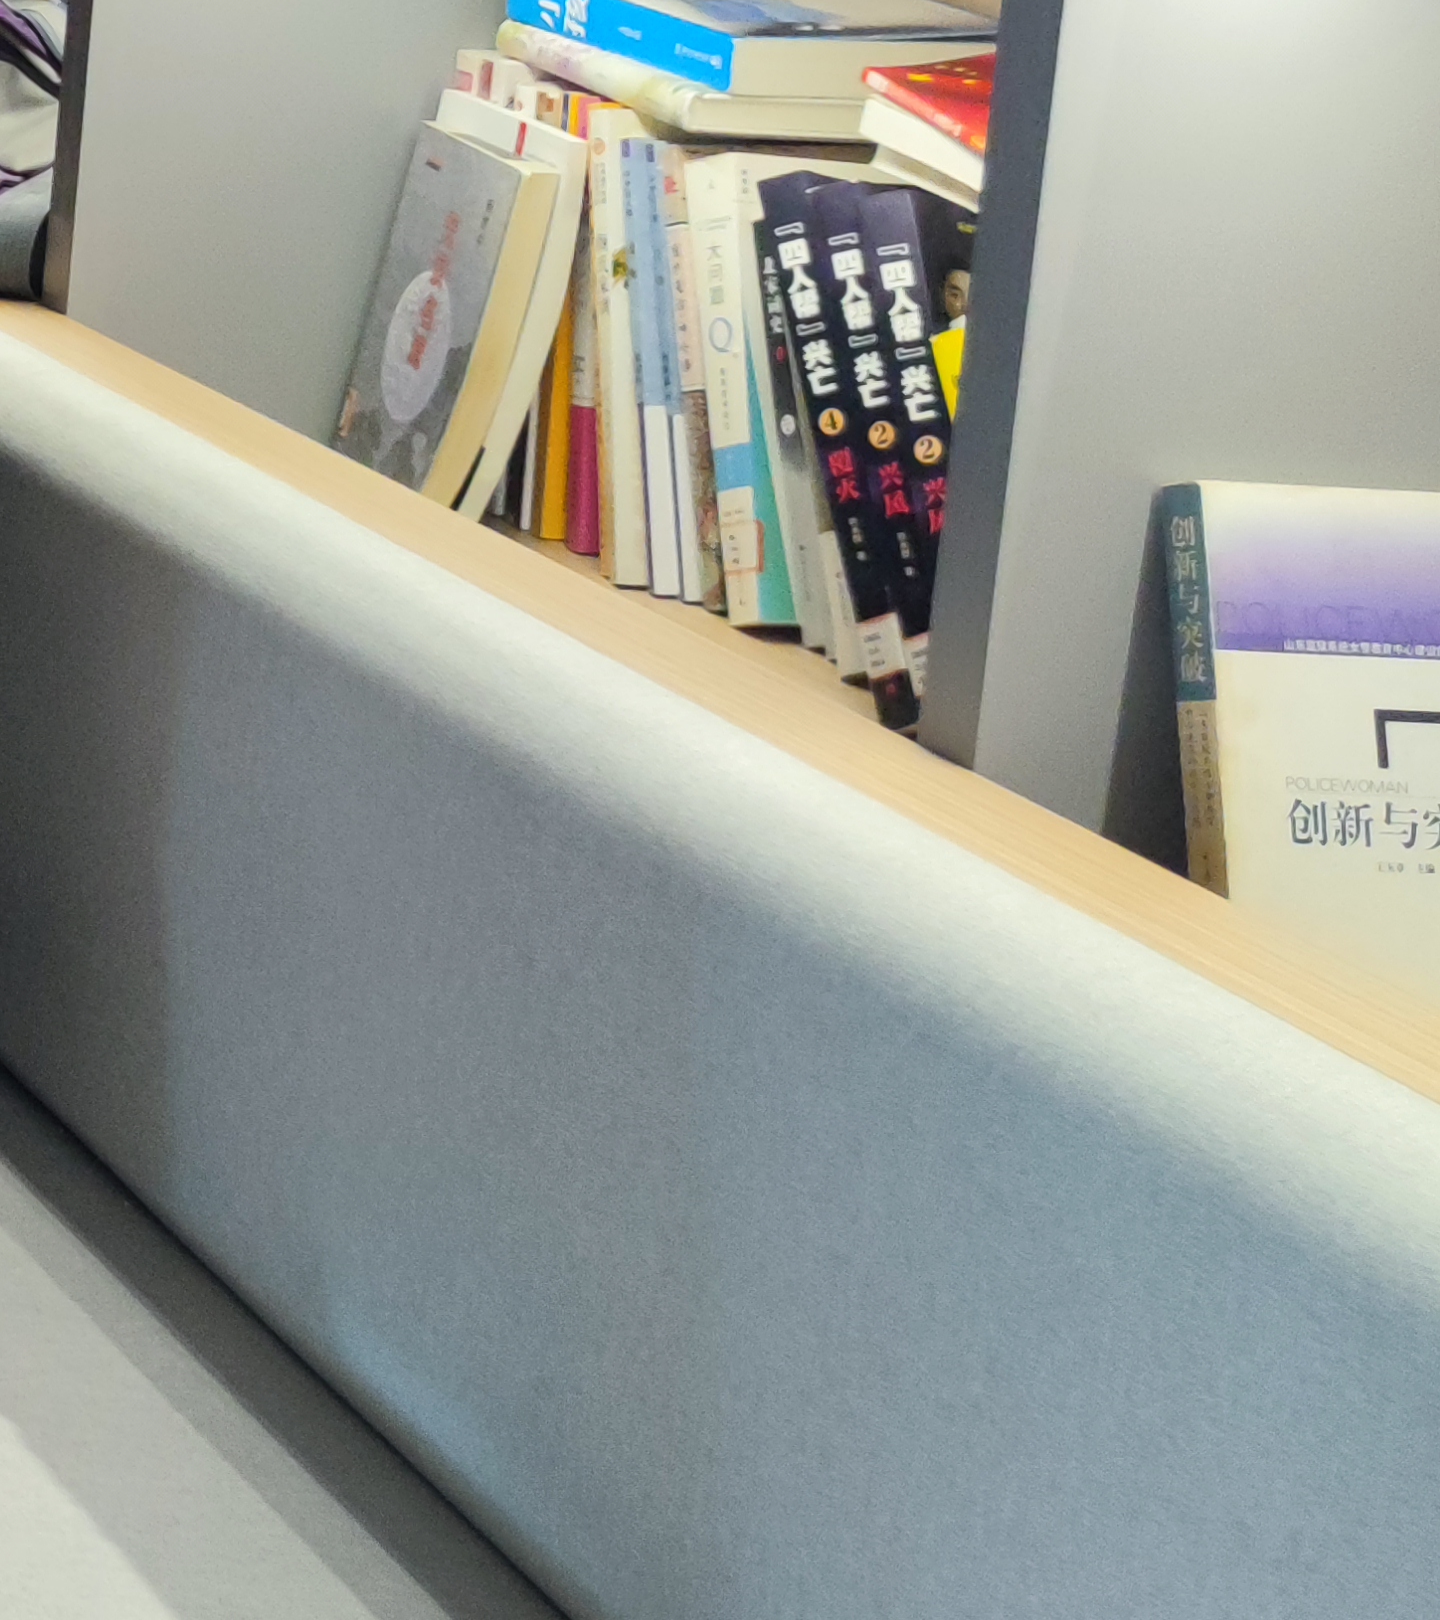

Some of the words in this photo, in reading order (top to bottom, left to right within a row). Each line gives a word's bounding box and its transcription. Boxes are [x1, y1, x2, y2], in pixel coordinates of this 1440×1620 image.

[1169, 515, 1208, 683] 创新与突破
[1285, 776, 1410, 795] POLICEWOMAN
